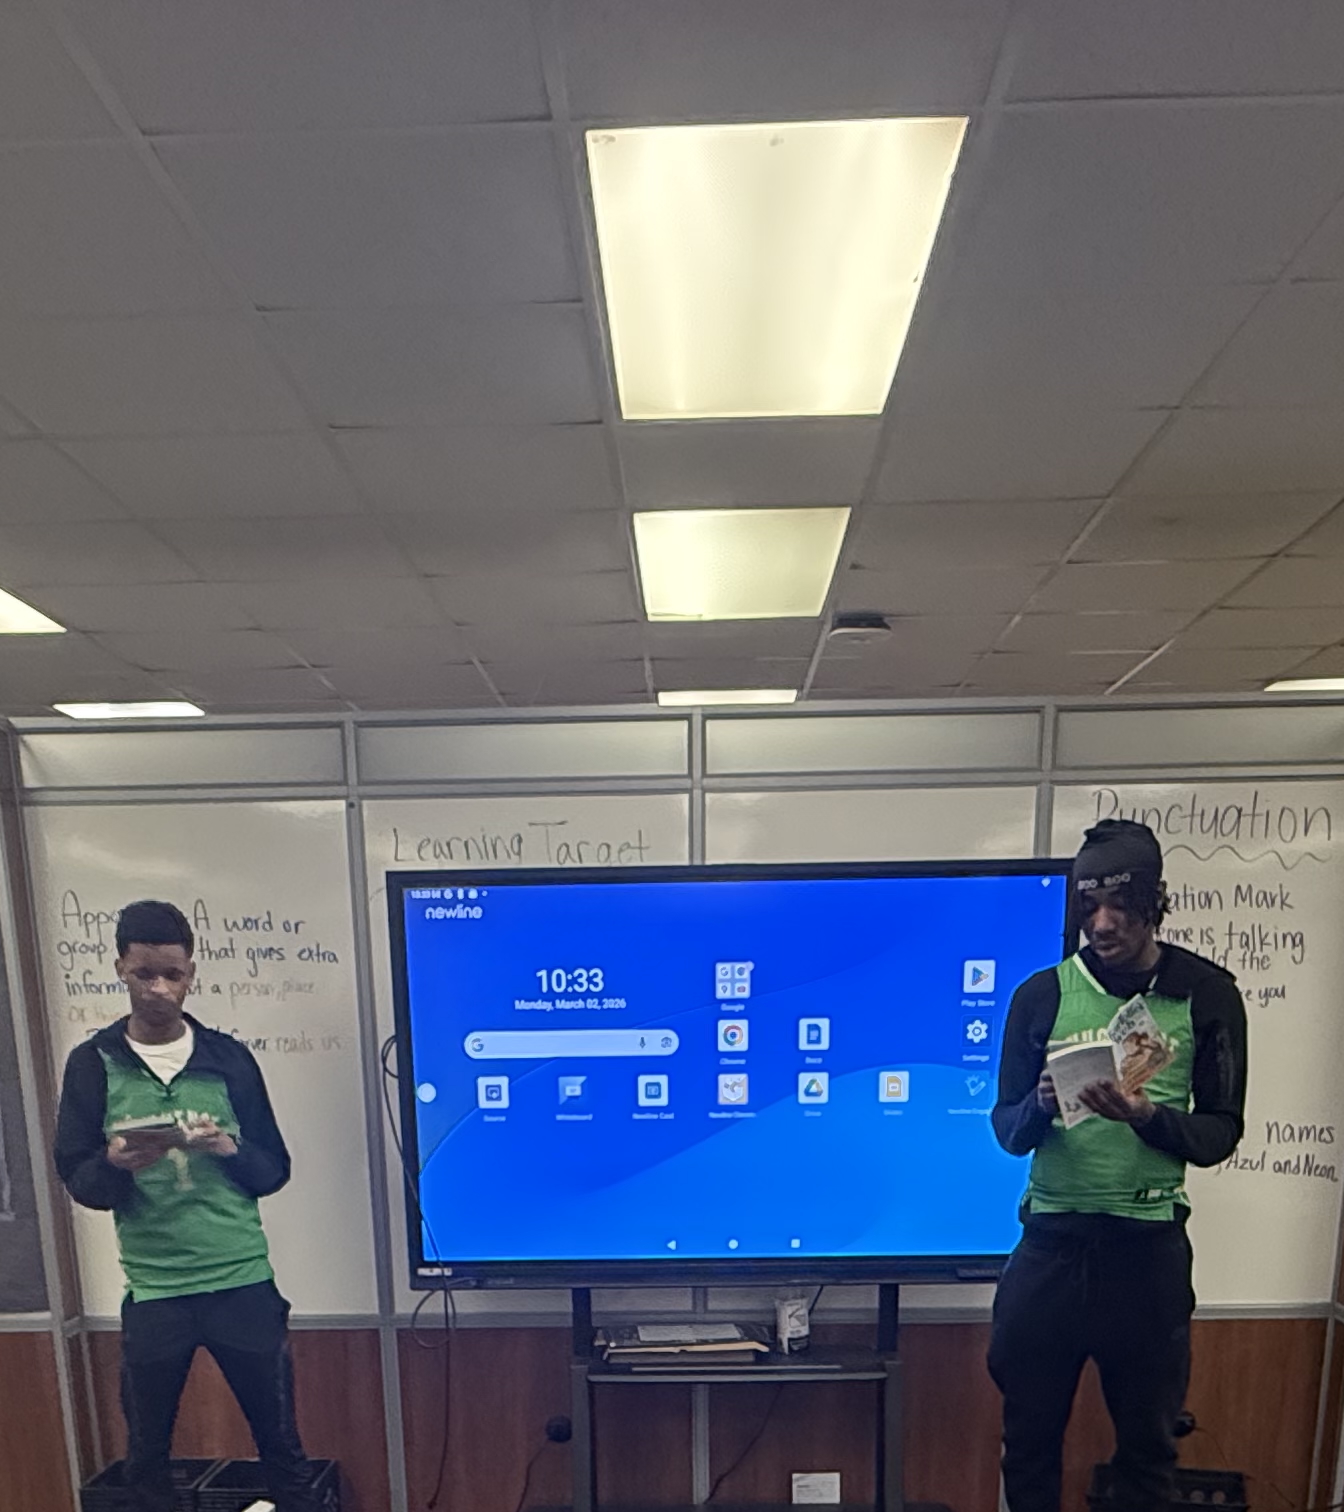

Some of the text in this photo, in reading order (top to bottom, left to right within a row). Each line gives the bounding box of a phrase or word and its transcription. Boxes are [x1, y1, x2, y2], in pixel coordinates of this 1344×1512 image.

[1092, 787, 1331, 843] Punctuation
[392, 819, 650, 866] Learning Target
[425, 903, 483, 920] newline
[1169, 882, 1294, 912] ation Mark
[193, 898, 211, 930] A
[224, 910, 274, 932] word
[282, 919, 306, 935] or
[57, 935, 339, 978] group that gives extra
[1224, 920, 1305, 966] talking
[536, 967, 605, 993] 10:33
[514, 999, 555, 1012] Monday,
[555, 998, 586, 1010] March
[1258, 984, 1286, 1009] you
[1266, 1121, 1335, 1144] names
[1225, 1147, 1266, 1172] Azul
[1272, 1154, 1301, 1175] and
